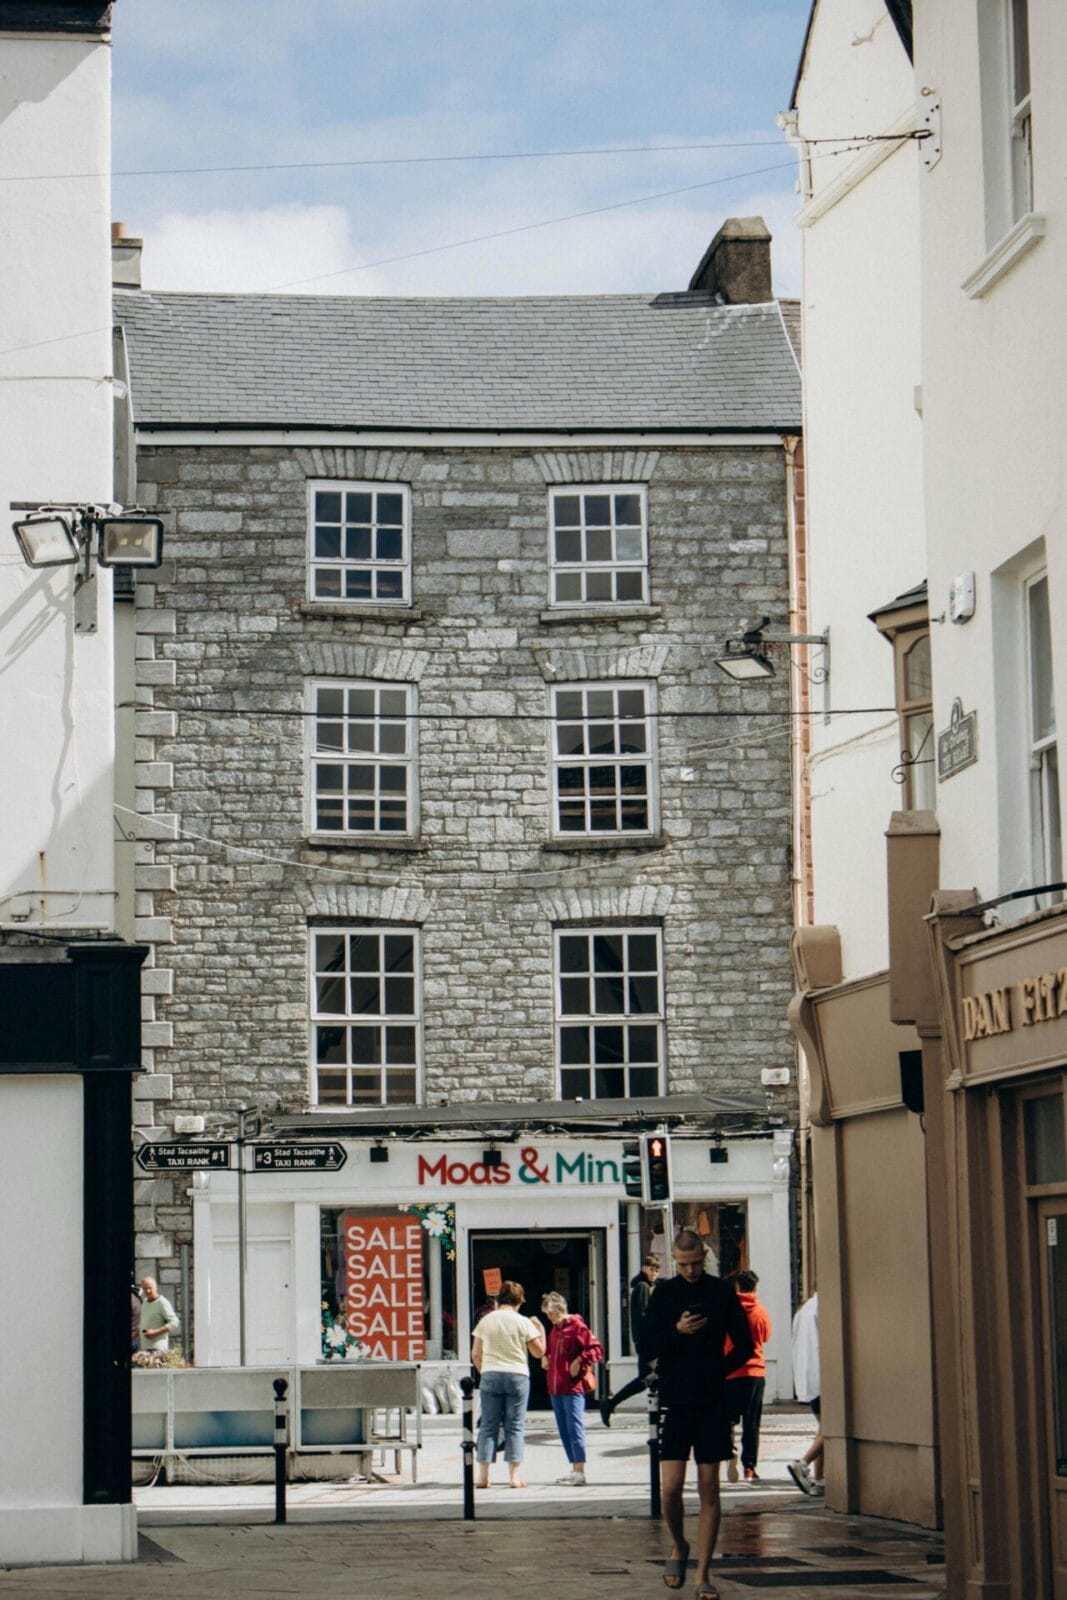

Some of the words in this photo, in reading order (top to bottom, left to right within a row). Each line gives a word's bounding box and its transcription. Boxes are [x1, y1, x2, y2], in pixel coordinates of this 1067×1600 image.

[962, 986, 1009, 1040] DAN
[158, 1147, 175, 1155] Stad
[211, 1150, 225, 1162] #1
[256, 1151, 272, 1165] #3
[274, 1148, 291, 1156] Stad
[167, 1158, 185, 1166] TAXI
[187, 1158, 210, 1166] RANK
[274, 1159, 291, 1167] TAXI
[294, 1159, 316, 1167] RANK
[518, 1146, 549, 1184] &
[556, 1151, 641, 1184] Mini
[347, 1225, 422, 1250] SALE
[347, 1253, 422, 1280] SALE
[348, 1282, 423, 1308] SALE
[348, 1310, 424, 1337] SALE
